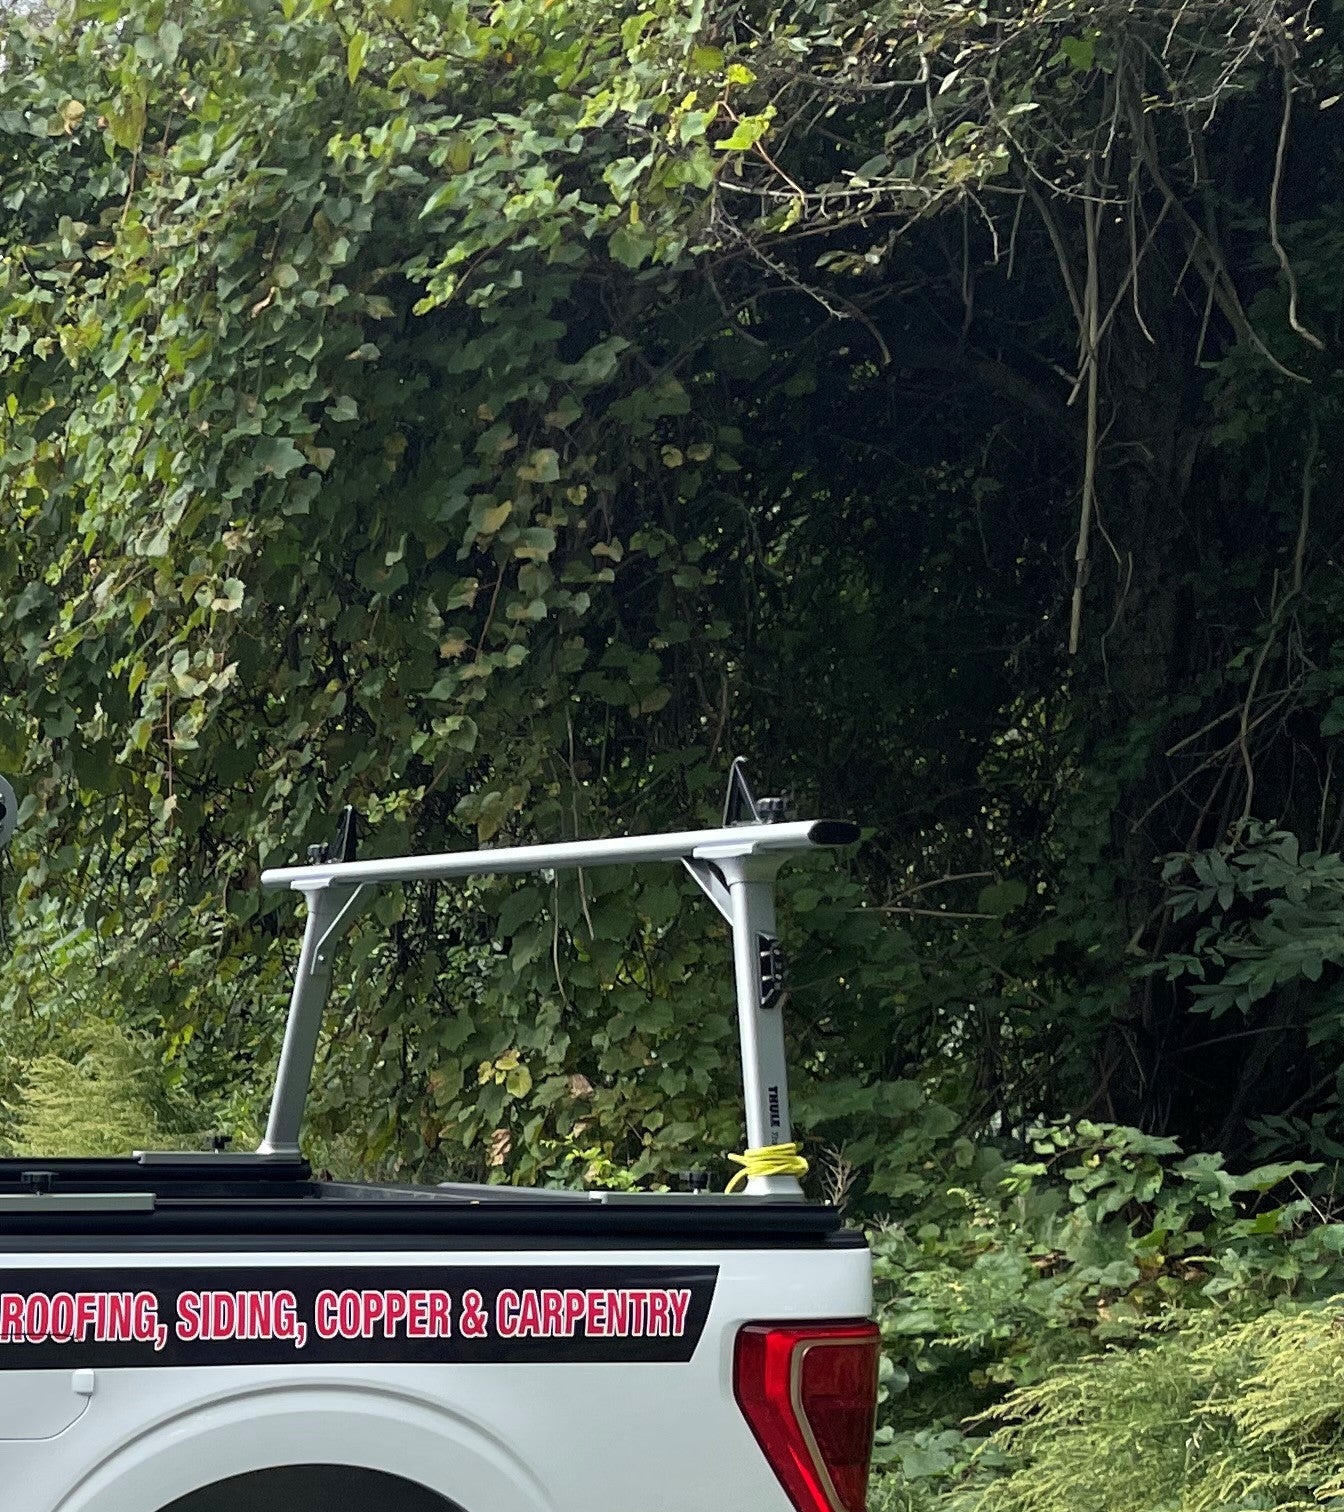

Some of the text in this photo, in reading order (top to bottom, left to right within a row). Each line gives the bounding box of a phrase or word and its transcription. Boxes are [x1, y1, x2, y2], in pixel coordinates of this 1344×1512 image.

[176, 1290, 307, 1349] SIDING,
[314, 1289, 452, 1339] COPPER
[459, 1288, 489, 1339] &
[495, 1288, 692, 1338] CARPENTRY
